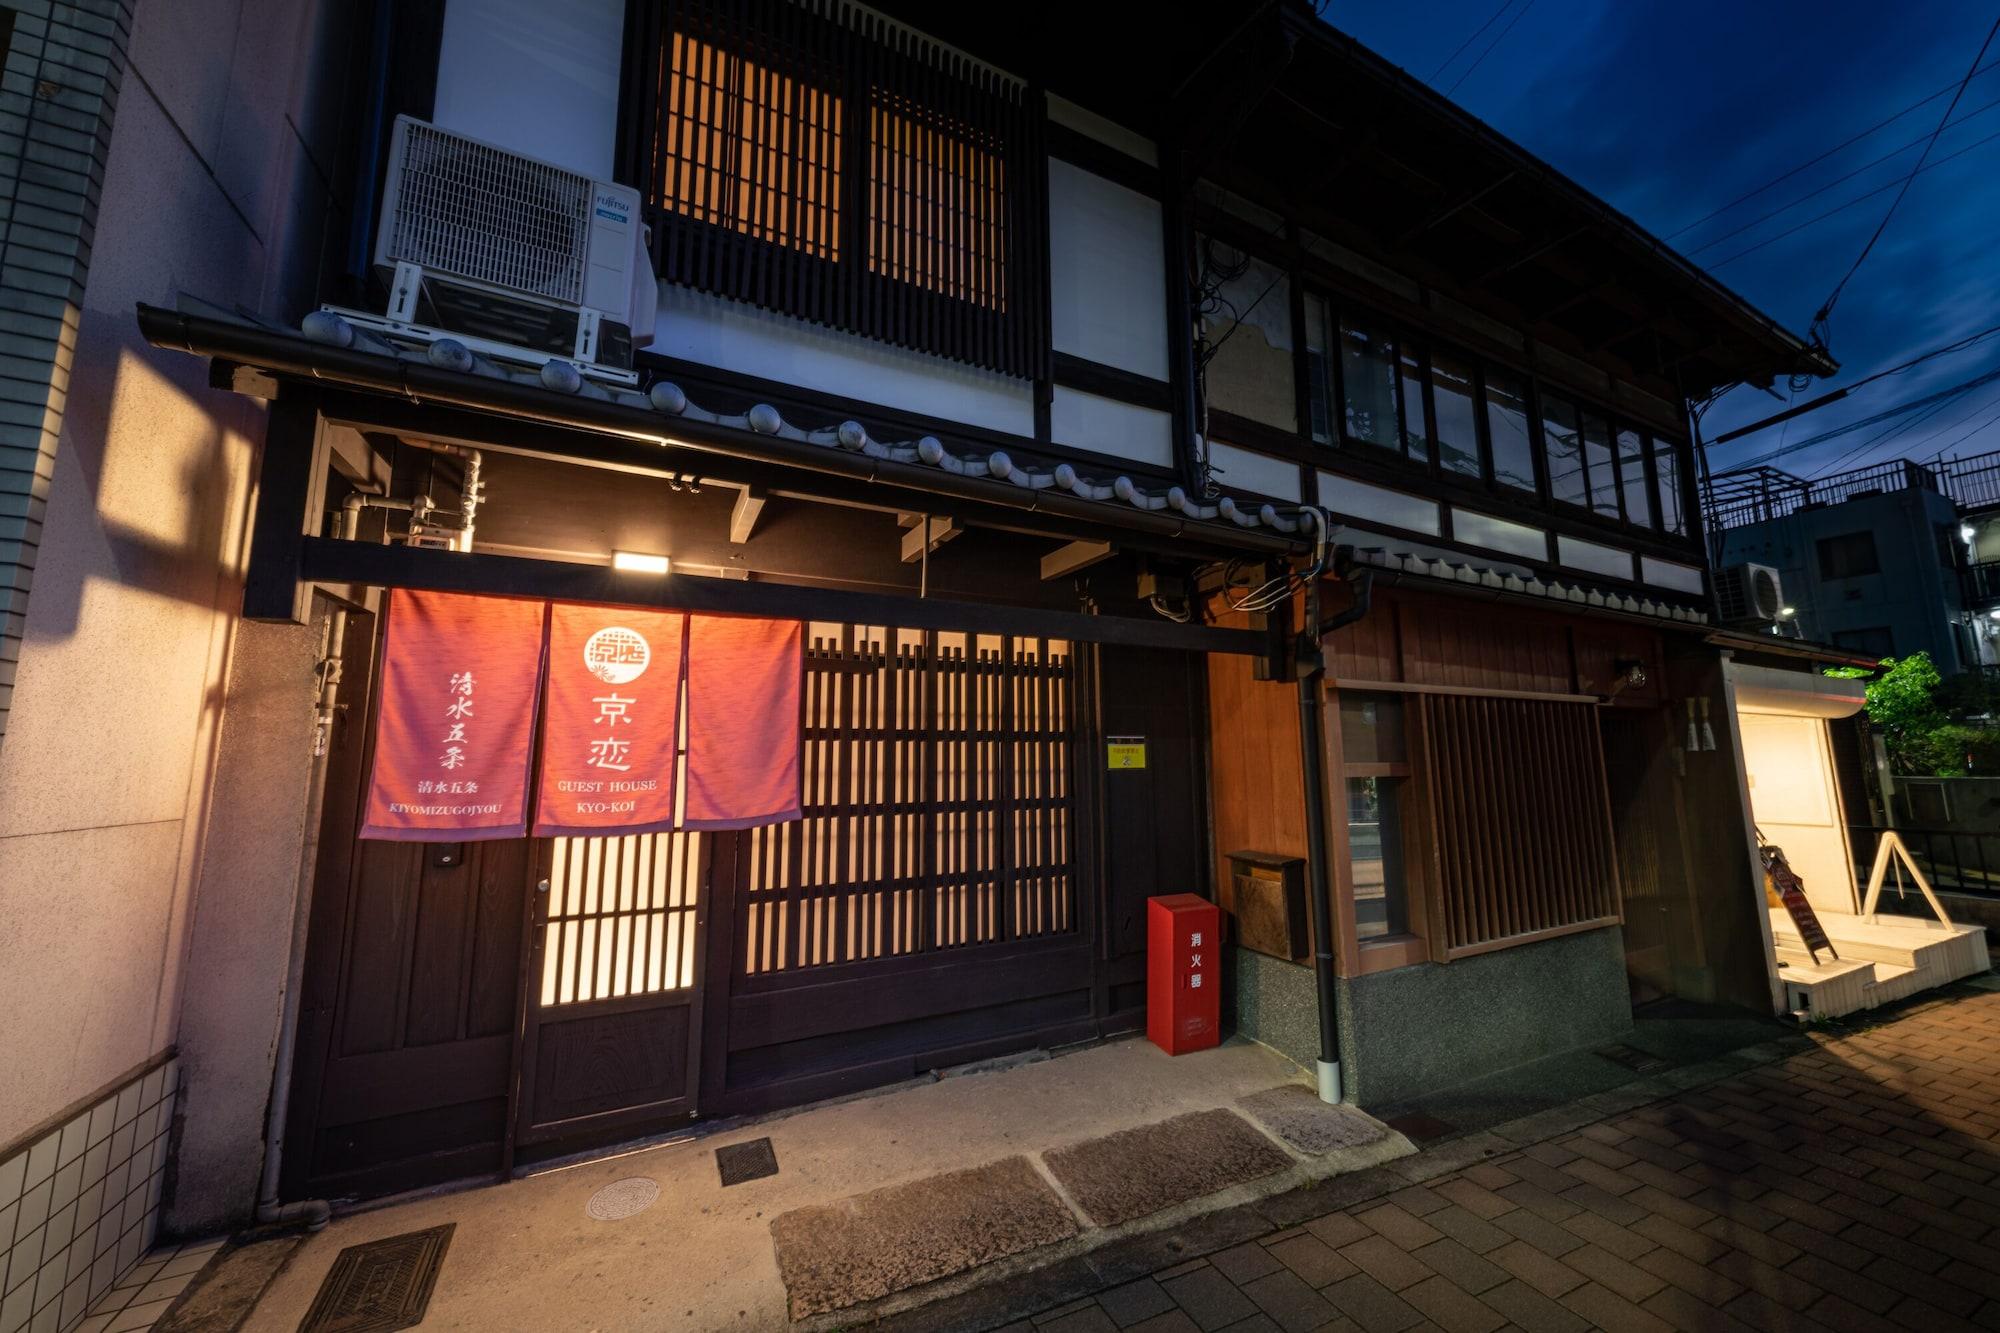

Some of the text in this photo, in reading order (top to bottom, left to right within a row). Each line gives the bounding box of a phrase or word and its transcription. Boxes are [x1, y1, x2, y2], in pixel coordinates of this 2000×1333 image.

[597, 195, 629, 211] FUJITSU
[439, 671, 477, 770] 清水五条
[587, 692, 637, 772] 京恋
[418, 780, 479, 794] 清水五条
[558, 780, 657, 793] GUEST HOUSE
[389, 803, 502, 816] KIYOMIZUGOJYOU
[577, 801, 636, 813] KYO-KOI
[1190, 932, 1202, 989] 消火器
